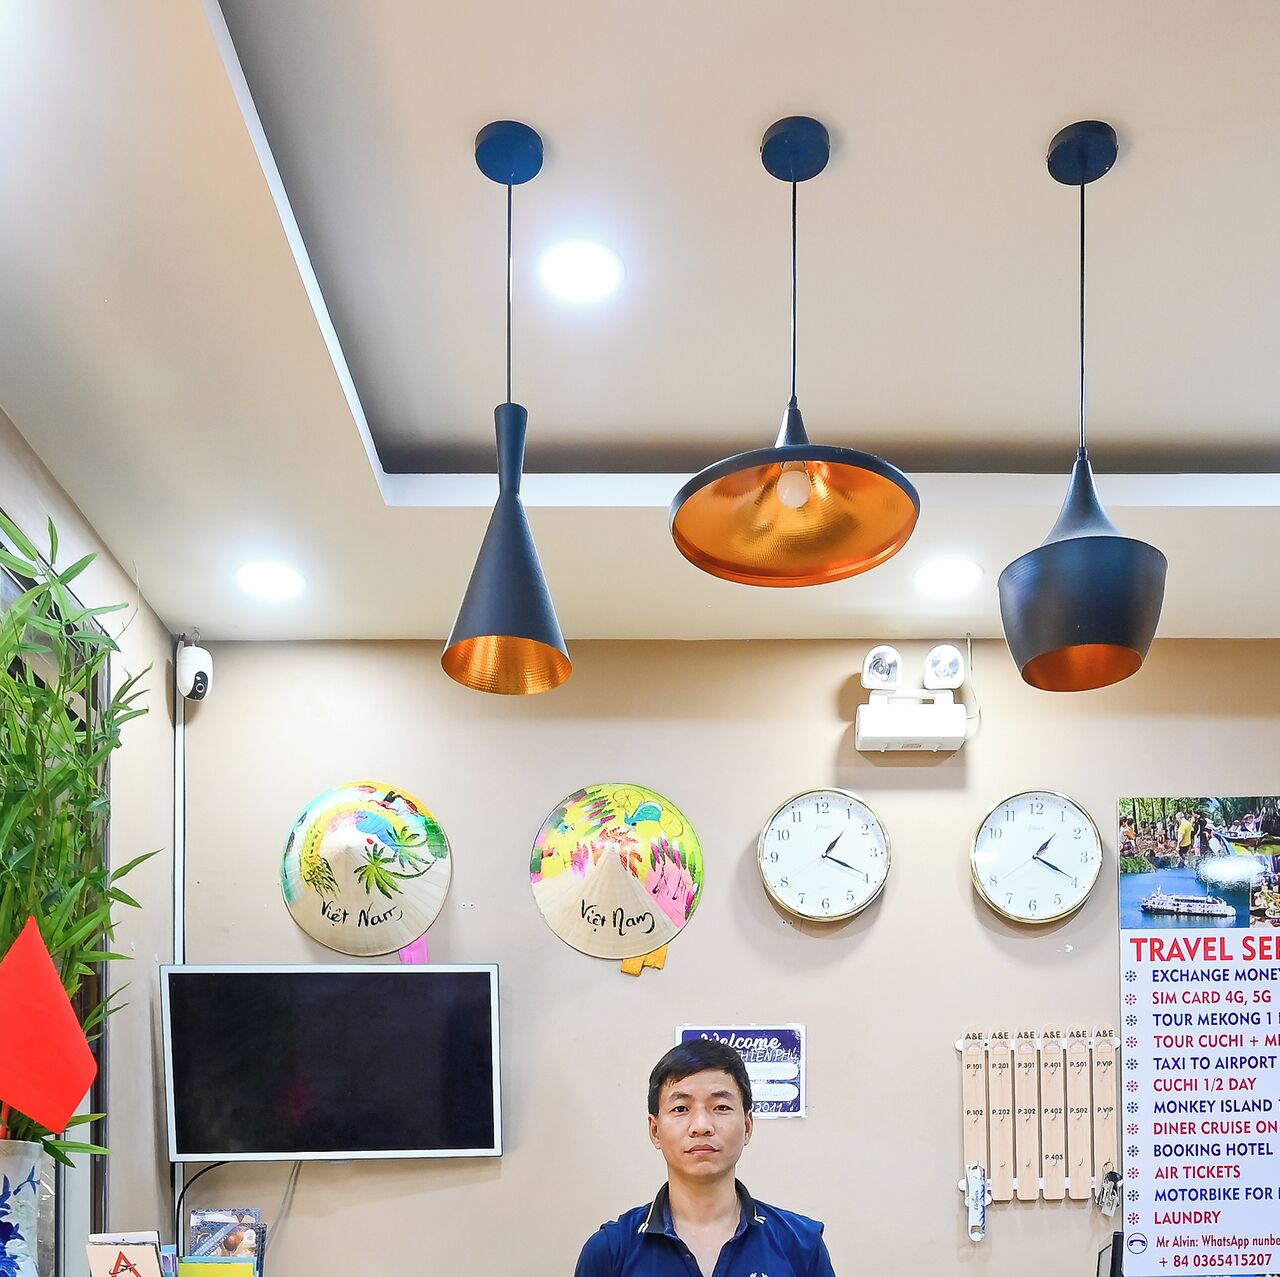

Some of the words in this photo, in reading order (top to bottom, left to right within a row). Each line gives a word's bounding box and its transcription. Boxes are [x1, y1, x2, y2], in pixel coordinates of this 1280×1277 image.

[815, 802, 829, 814] 12
[846, 808, 850, 819] 1
[1029, 803, 1044, 814] 12
[792, 811, 801, 822] 11
[1006, 810, 1015, 822] 11
[1061, 810, 1064, 822] 1
[777, 830, 790, 840] 10
[861, 824, 869, 835] 2
[990, 828, 1002, 839] 10
[1074, 828, 1081, 839] 2
[770, 852, 778, 862] 9
[870, 848, 877, 858] 3
[1081, 851, 1088, 863] 3
[781, 876, 789, 887] 8
[989, 875, 998, 886] 8
[1071, 877, 1077, 888] 4
[798, 893, 805, 904] 7
[847, 890, 854, 901] 5
[1006, 893, 1013, 904] 7
[1054, 893, 1061, 905] 5
[822, 898, 830, 909] 6
[1029, 900, 1037, 911] 6
[358, 902, 403, 927] Nam
[1130, 937, 1233, 962] TRAVEL
[1152, 968, 1229, 982] EXCHANGE
[1152, 991, 1177, 1004] SIM
[1182, 991, 1220, 1004] CARD
[1226, 990, 1248, 1005] 4G,
[1254, 990, 1271, 1003] 5G
[1153, 1013, 1193, 1026] TOUR
[1198, 1012, 1261, 1025] MEKONG
[1266, 1013, 1271, 1025] 1
[992, 1032, 1008, 1040] A&E
[1043, 1031, 1061, 1039] A&E
[1096, 1030, 1113, 1038] A&E
[1154, 1035, 1194, 1048] TOUR
[1198, 1035, 1243, 1047] CUCHI
[1250, 1036, 1259, 1046] +
[1153, 1057, 1185, 1070] TAXI
[1191, 1057, 1210, 1070] TO
[1215, 1056, 1277, 1069] AIRPORT
[1153, 1079, 1198, 1091] CUCHI
[1204, 1078, 1223, 1091] 1/2
[1229, 1077, 1256, 1090] DAY
[1154, 1101, 1216, 1113] MONKEY
[1221, 1099, 1272, 1113] ISLAND
[1154, 1122, 1196, 1135] DINER
[1201, 1121, 1250, 1134] CRUISE
[1256, 1120, 1278, 1133] ON
[1154, 1144, 1221, 1157] BOOKING
[1226, 1143, 1273, 1156] HOTEL
[1155, 1167, 1178, 1179] AIR
[1183, 1165, 1240, 1178] TICKETS
[1155, 1188, 1240, 1201] MOTORBIKE
[1245, 1188, 1273, 1200] FOR
[1154, 1211, 1221, 1225] LAUNDRY
[1156, 1236, 1170, 1248] Mr
[1173, 1236, 1198, 1248] Alvin:
[1202, 1235, 1249, 1249] WhatsApp
[1160, 1257, 1168, 1266] +
[1173, 1256, 1188, 1267] 84
[1194, 1253, 1272, 1267] 0365415207
